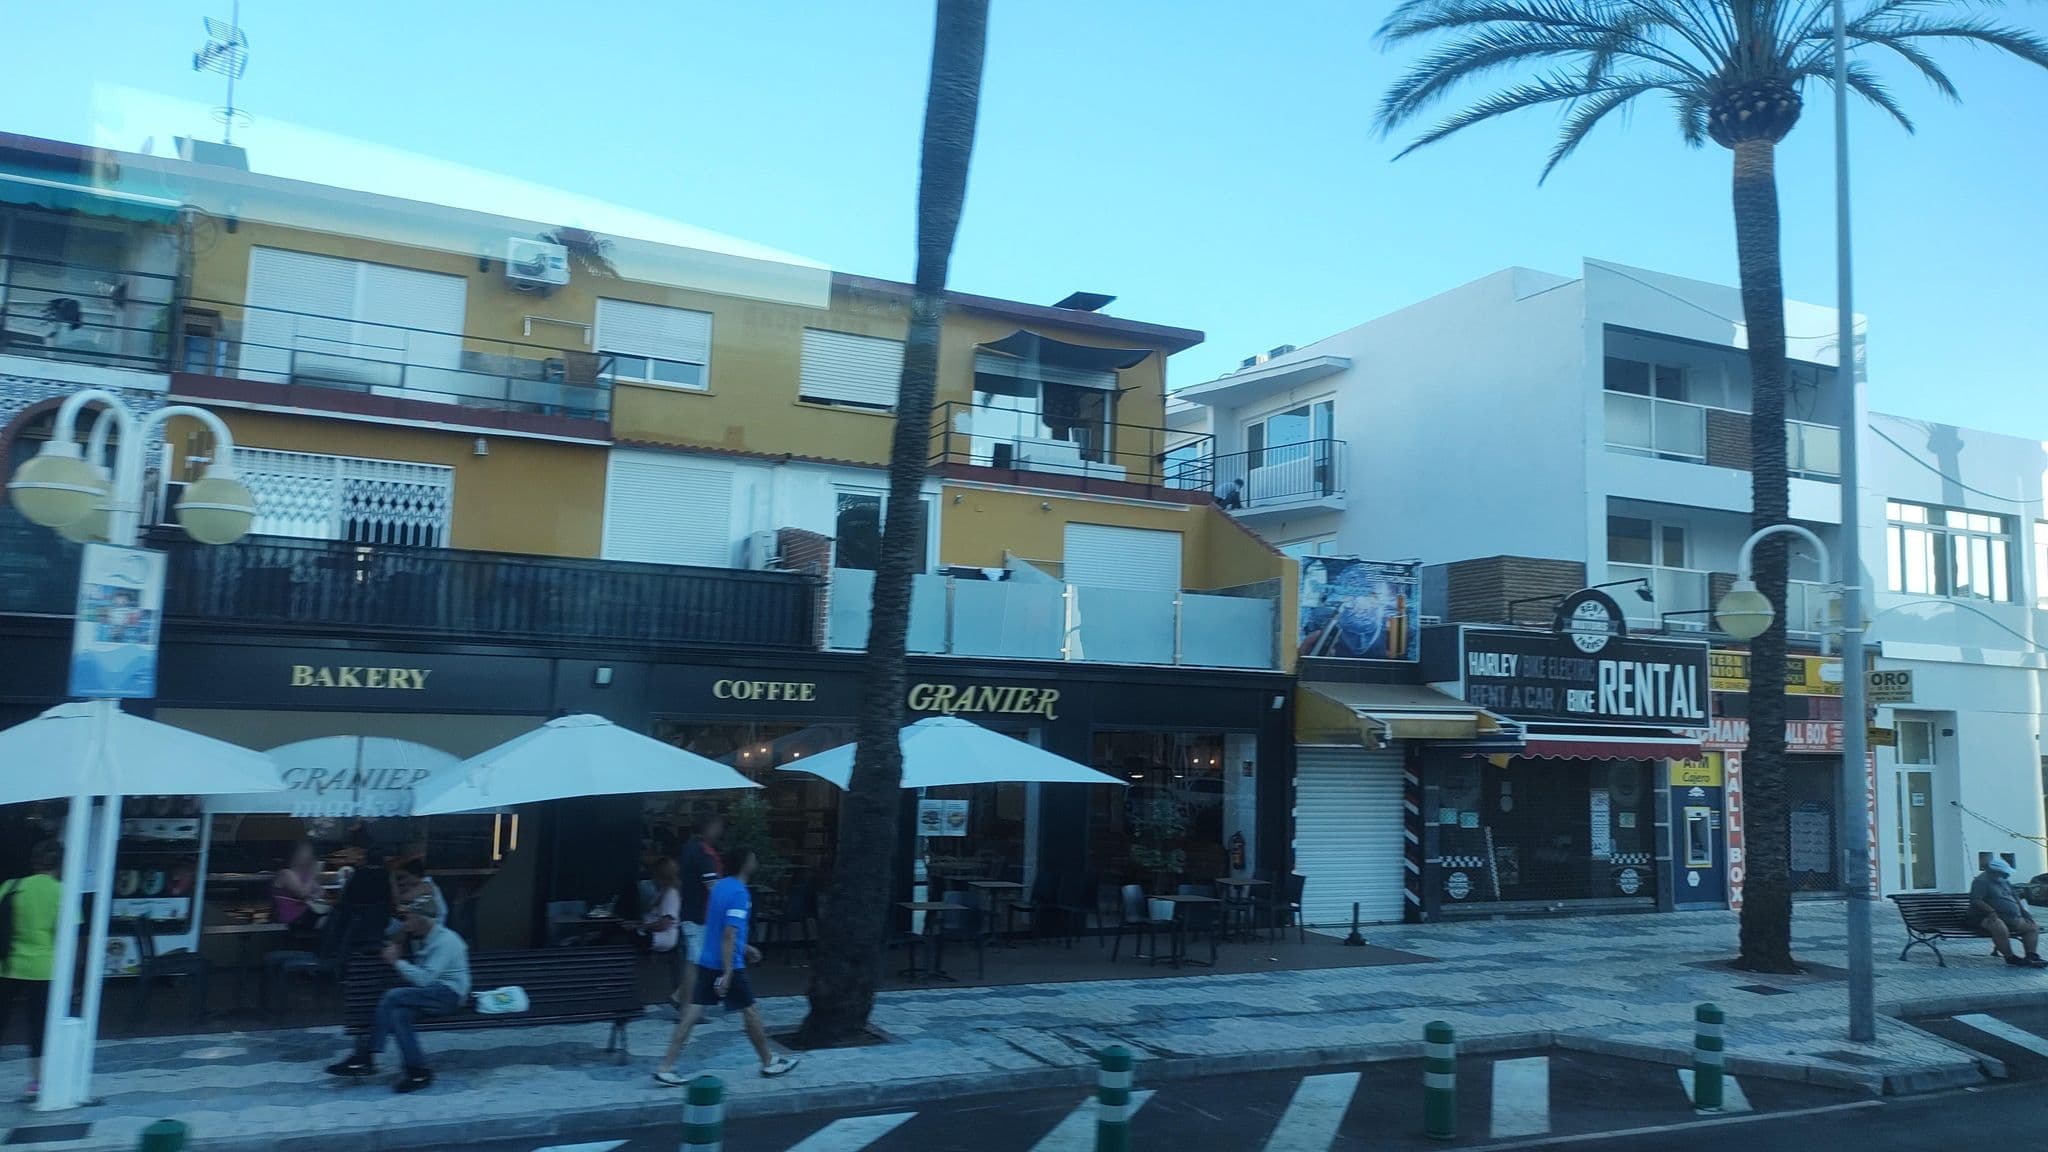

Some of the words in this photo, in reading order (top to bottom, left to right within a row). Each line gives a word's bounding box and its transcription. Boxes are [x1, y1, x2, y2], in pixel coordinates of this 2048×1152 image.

[1469, 652, 1518, 677] HARLEY
[1711, 666, 1743, 678] NION
[290, 665, 432, 690] BAKERY
[713, 679, 816, 701] COFFEE
[1599, 660, 1704, 718] RENTAL
[1871, 672, 1909, 686] ORO
[908, 683, 1060, 719] GRANIER
[1524, 686, 1554, 709] CAR
[1566, 689, 1596, 712] BIKE
[1784, 722, 1804, 744] ALL
[1806, 723, 1828, 745] BOX
[282, 767, 431, 795] GRANIER
[1727, 758, 1740, 831] CALL
[1729, 848, 1743, 902] BOX
